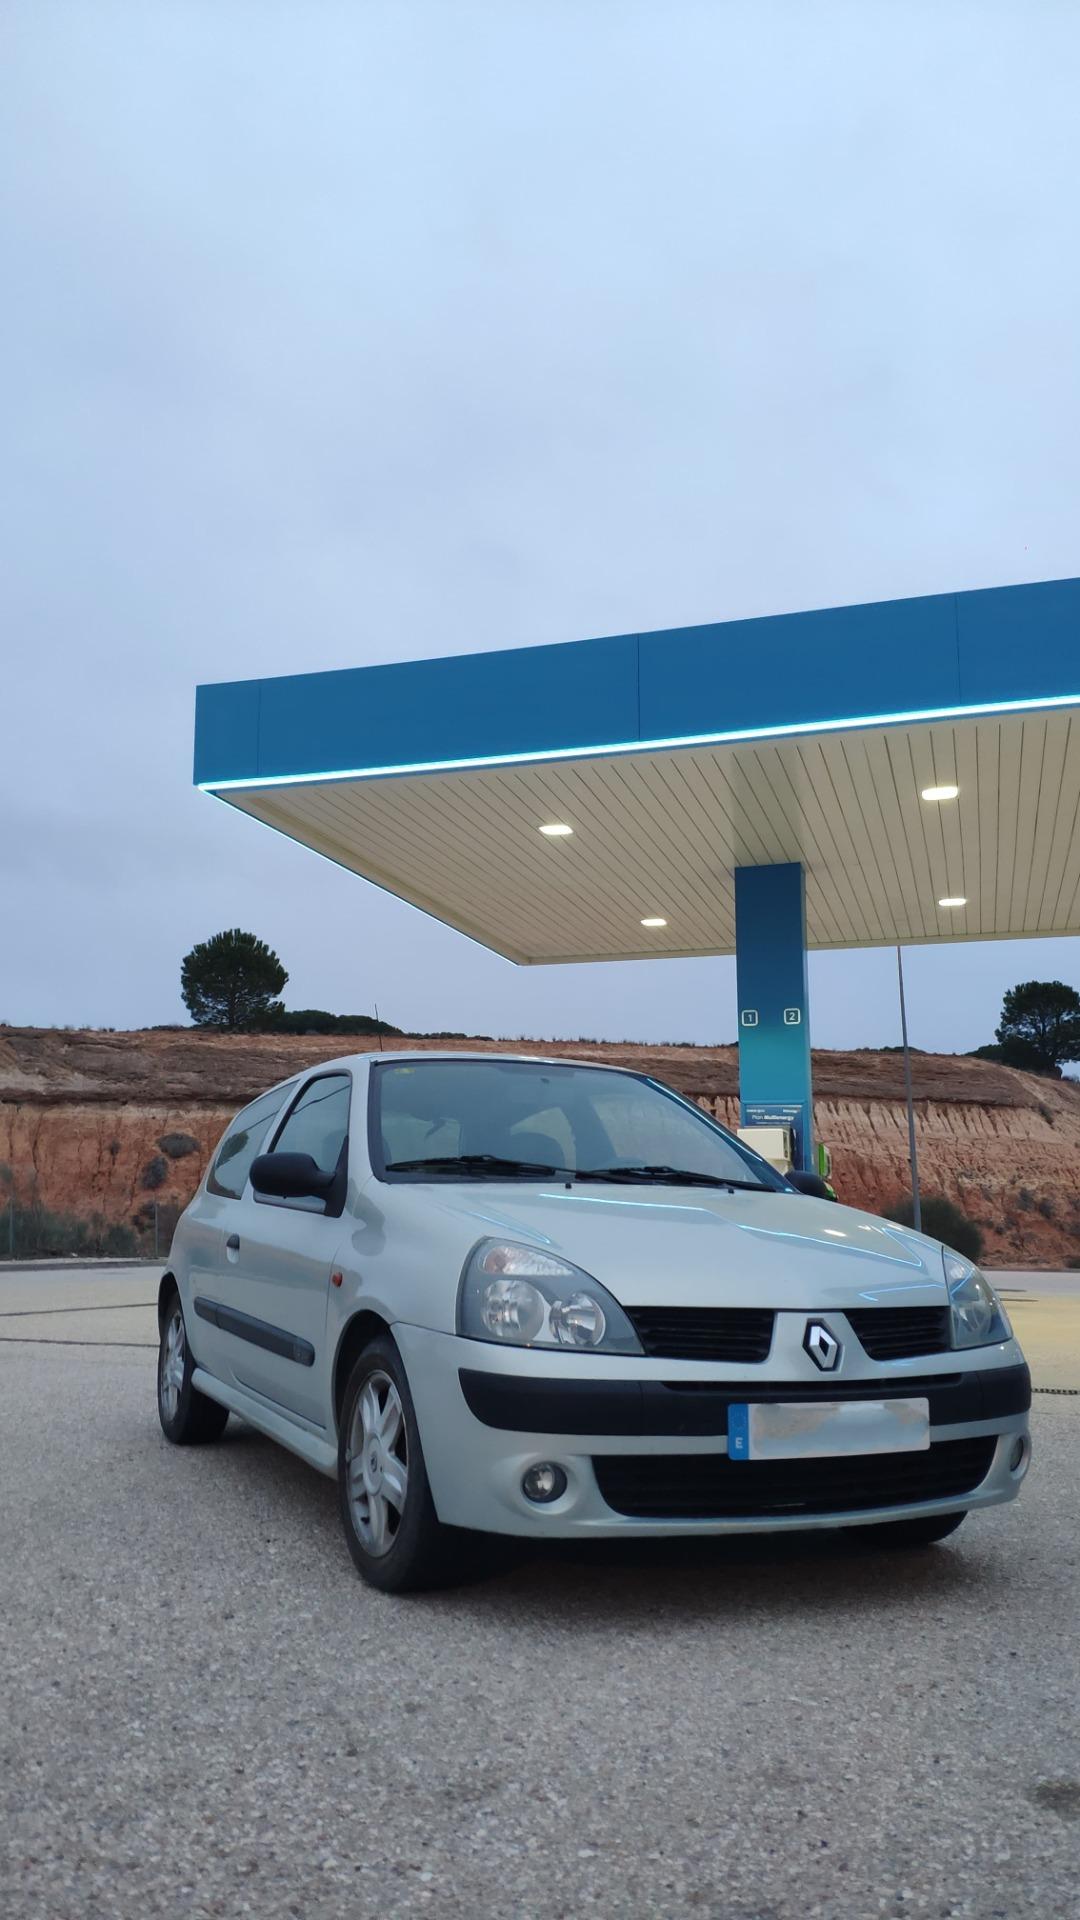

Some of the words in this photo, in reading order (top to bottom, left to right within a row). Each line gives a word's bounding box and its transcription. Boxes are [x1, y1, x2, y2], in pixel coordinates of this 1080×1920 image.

[748, 1014, 752, 1022] 1
[789, 1012, 796, 1021] 2
[735, 1436, 744, 1449] E
